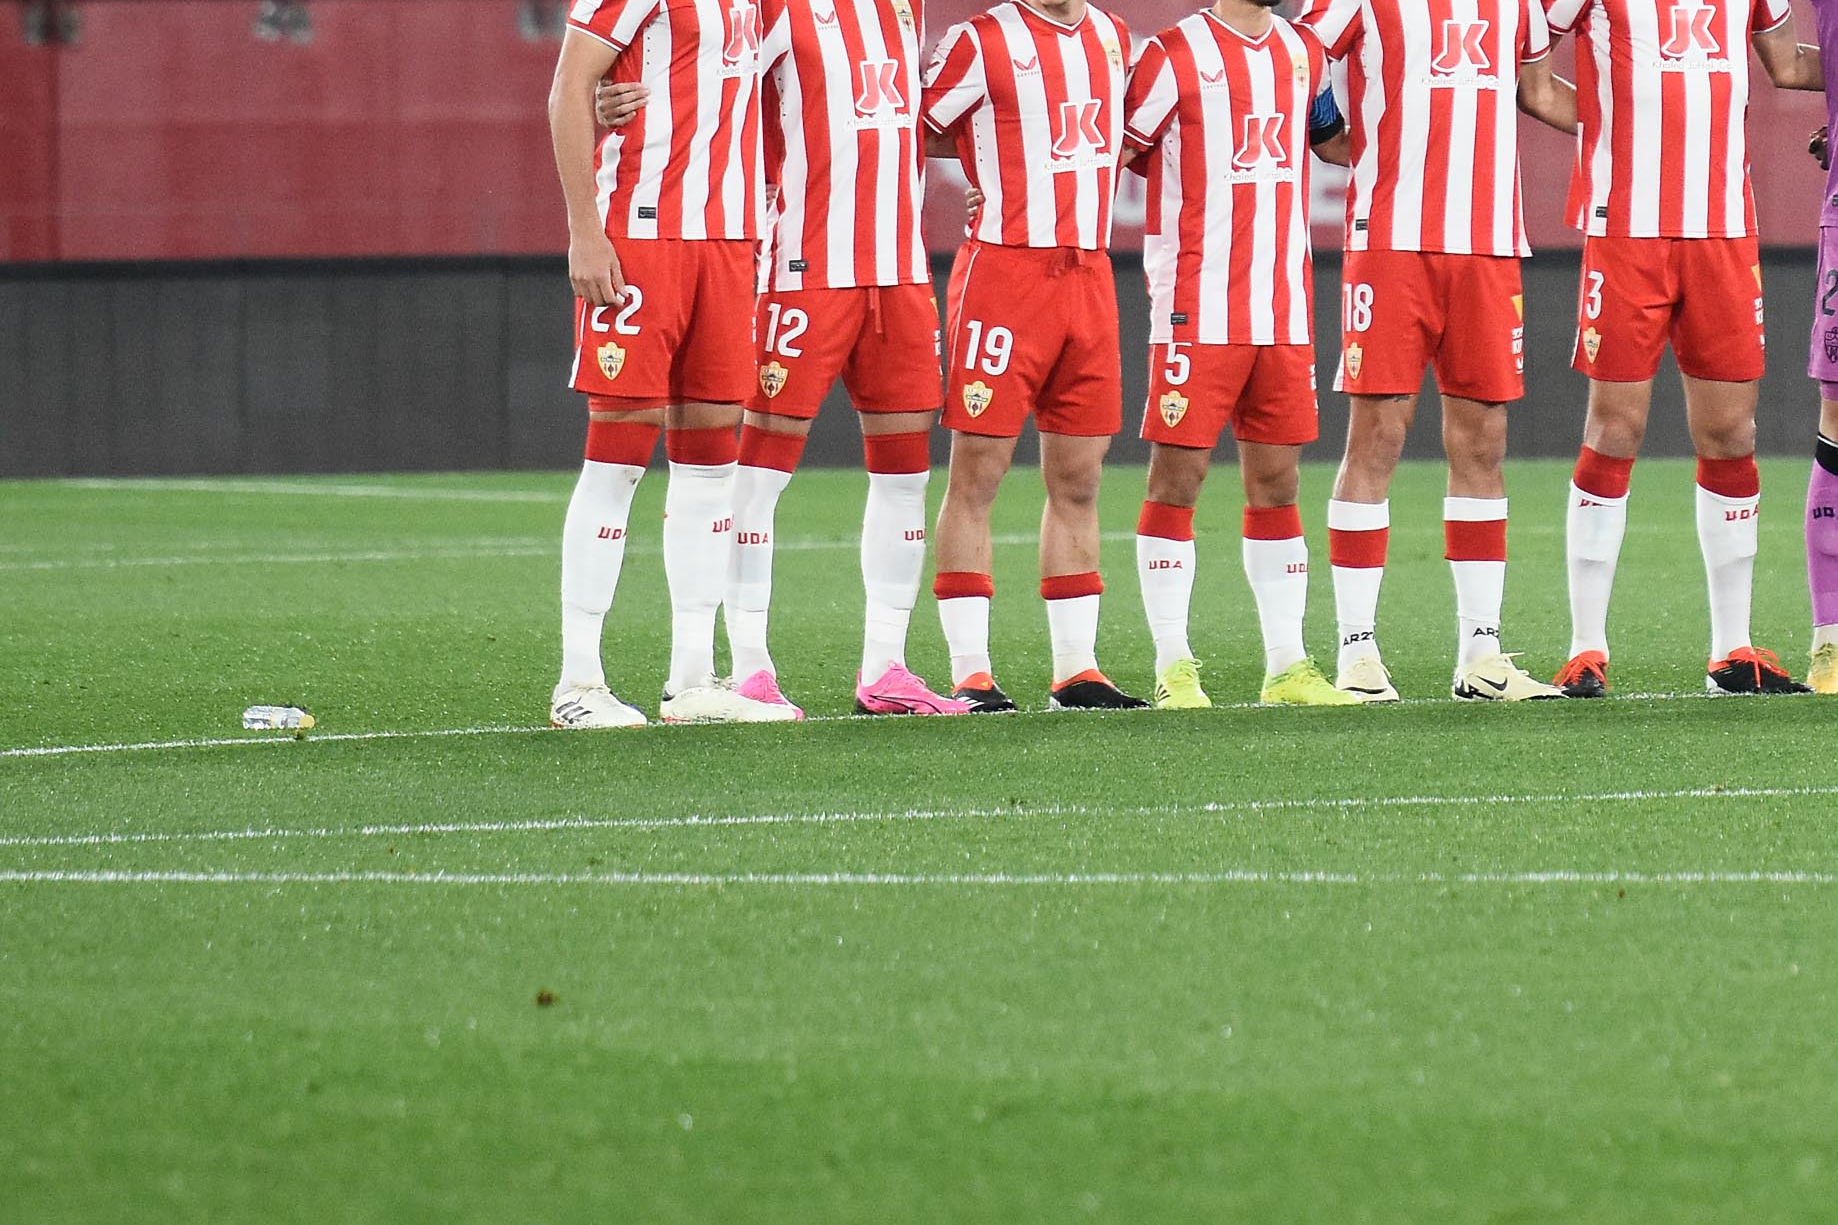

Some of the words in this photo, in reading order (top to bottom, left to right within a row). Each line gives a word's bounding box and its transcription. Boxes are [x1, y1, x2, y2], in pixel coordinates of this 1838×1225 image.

[1431, 19, 1491, 73] JK
[1661, 5, 1722, 57] JK
[854, 59, 905, 114] JK
[1651, 58, 1685, 71] Khaled
[1052, 98, 1106, 157] JK
[1233, 113, 1288, 168] JK
[1343, 282, 1375, 333] 18
[1586, 270, 1605, 320] 3
[764, 303, 809, 358] 12
[965, 319, 1015, 376] 19
[1164, 342, 1192, 386] 5
[737, 531, 769, 545] UDA
[1148, 560, 1183, 570] UDA
